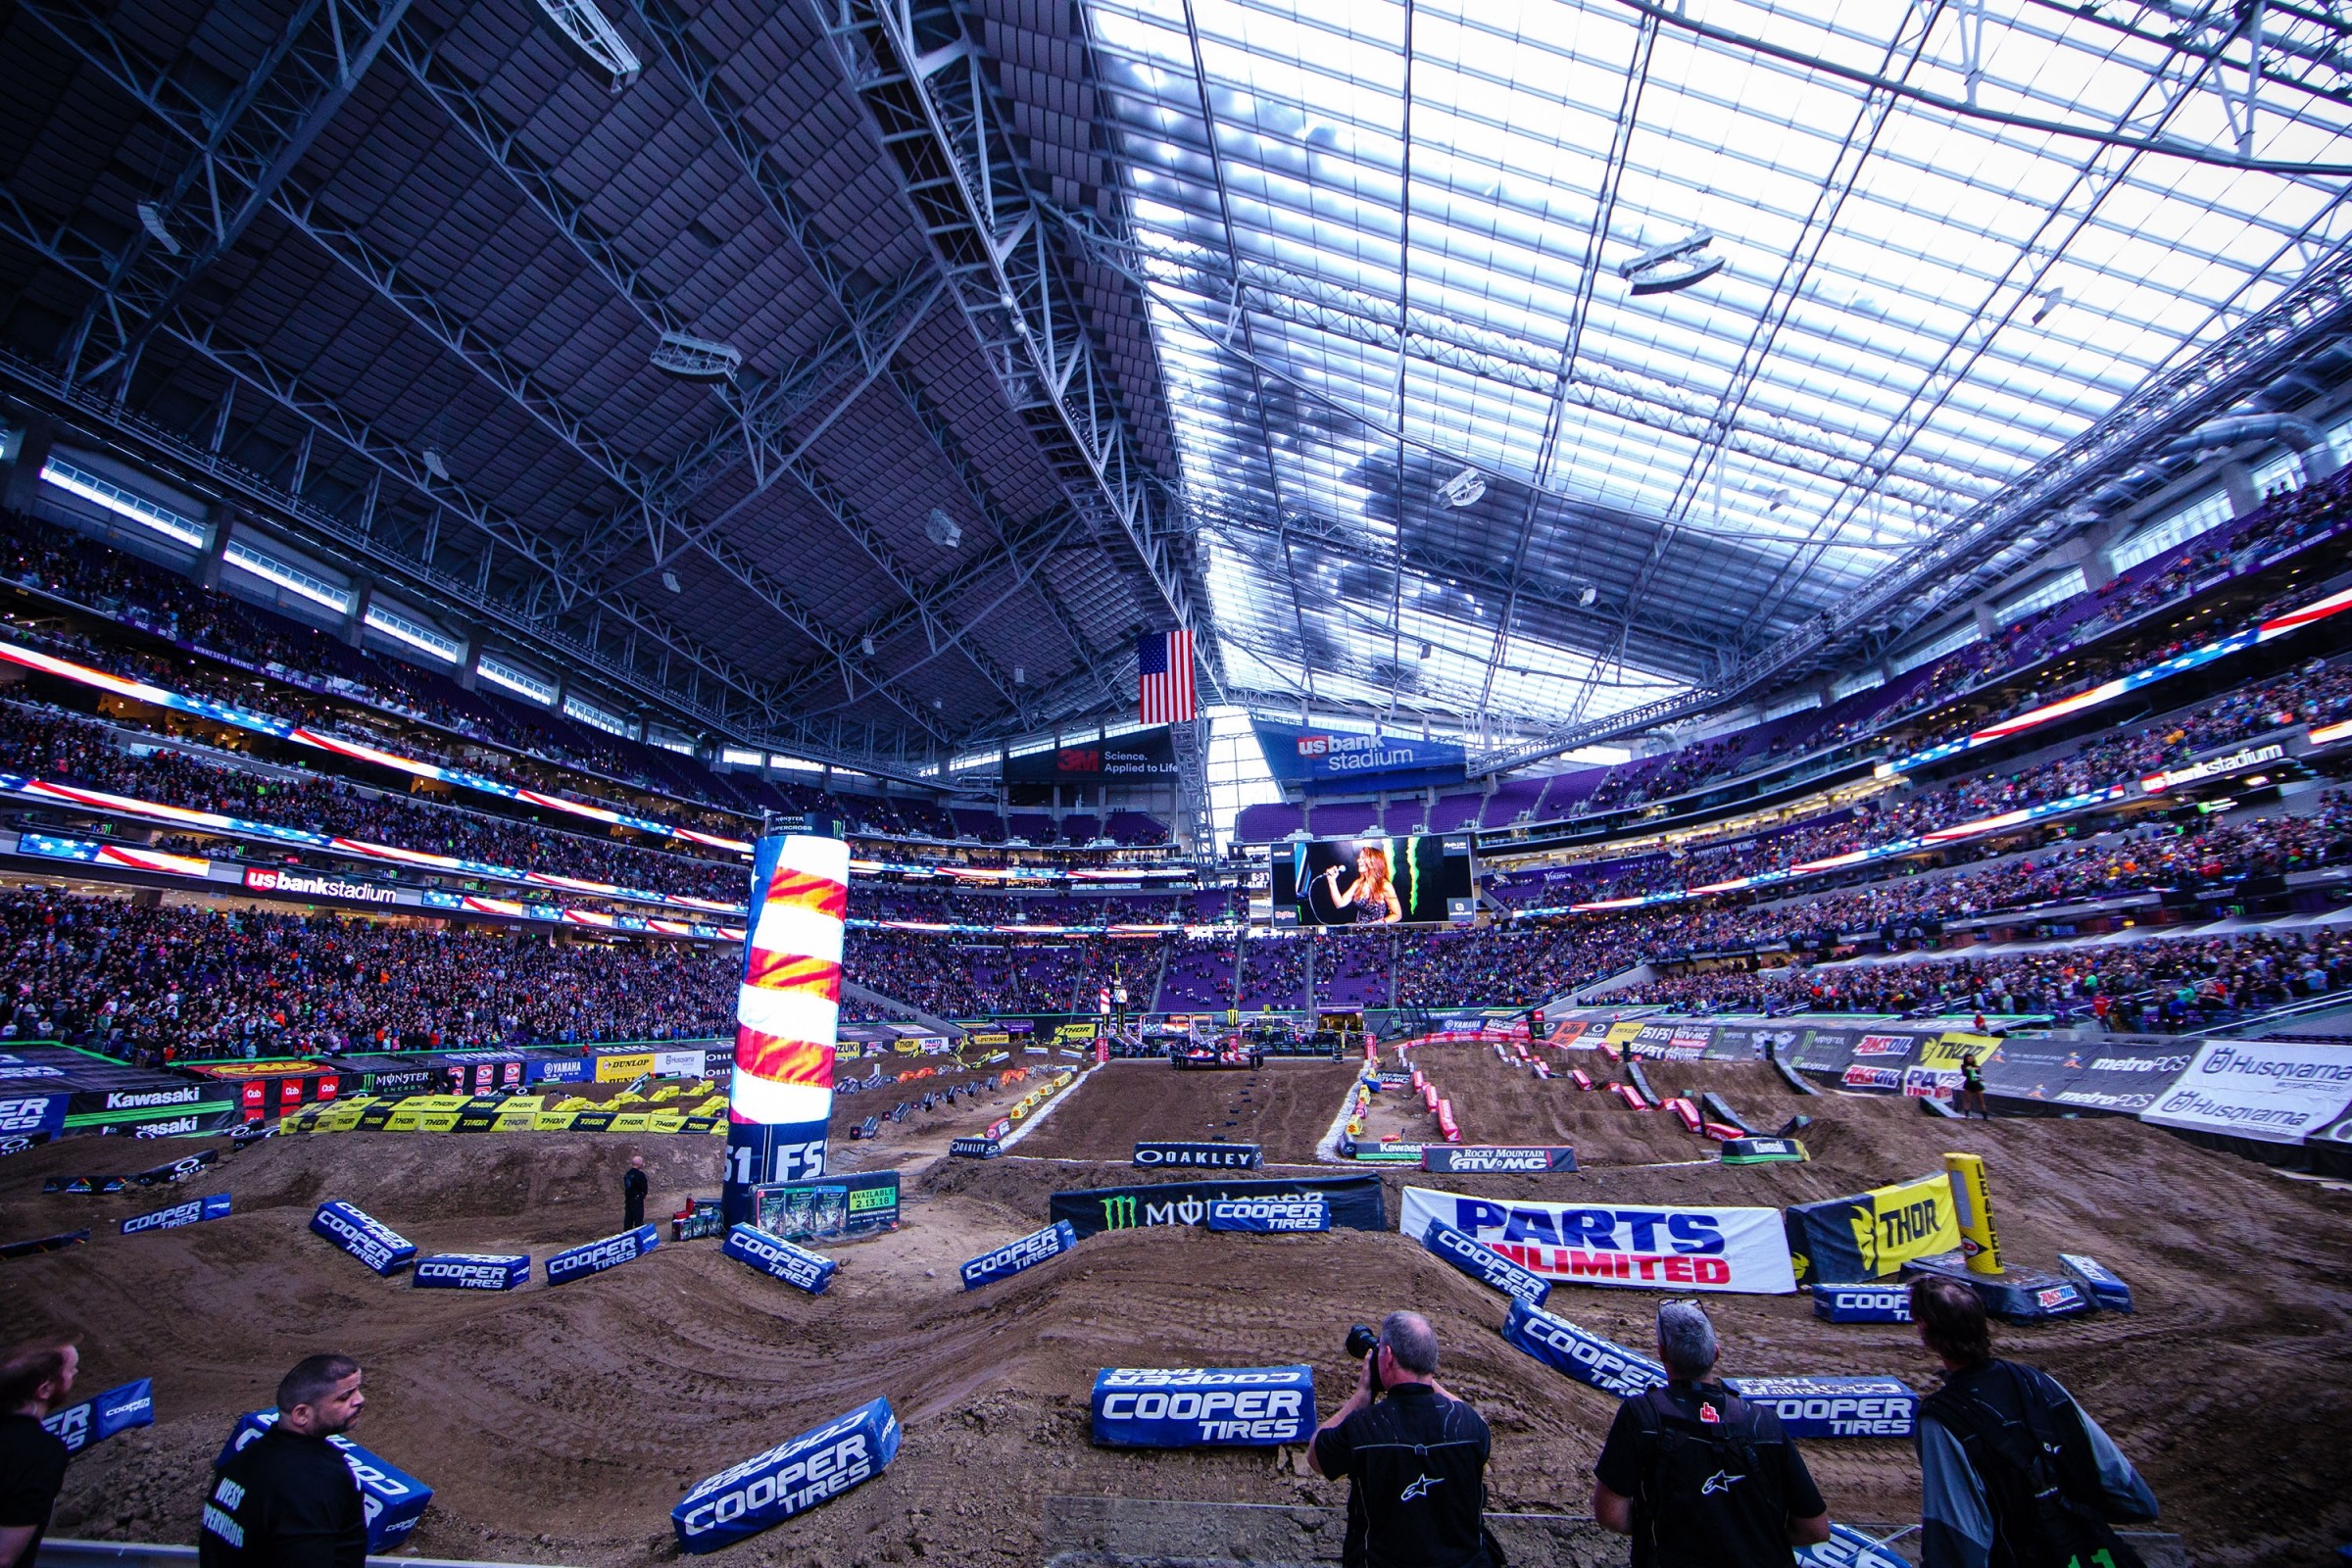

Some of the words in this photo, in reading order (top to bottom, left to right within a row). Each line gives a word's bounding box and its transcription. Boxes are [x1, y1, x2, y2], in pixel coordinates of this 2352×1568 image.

[1056, 749, 1099, 772] 3M
[1104, 751, 1148, 760] Science.
[1328, 748, 1413, 770] stadium
[1104, 762, 1145, 774] Applied
[1856, 1037, 1913, 1054] AMSOIL
[553, 1060, 582, 1072] YAMAHA
[612, 1058, 649, 1068] DUNLOP
[2090, 1054, 2191, 1072] metroPCS
[2228, 1054, 2352, 1081] Husqvarna
[376, 1072, 429, 1087] MONSTER
[1844, 1066, 1902, 1088] AMSOIL
[107, 1087, 200, 1109] Kawasaki
[2054, 1091, 2156, 1108] metroPCS
[424, 1118, 449, 1127] THOR
[579, 1117, 606, 1126] THOR
[2185, 1098, 2311, 1126] Husqvarna
[655, 1120, 676, 1129] THOR
[687, 1121, 710, 1131] THOR
[1165, 1151, 1250, 1166] OAKLEY
[1464, 1149, 1494, 1158] ROCKY
[1495, 1150, 1544, 1158] MOUNTAIN
[851, 1188, 895, 1200] AVAILABLE
[856, 1196, 890, 1207] 2.13.18
[123, 1200, 202, 1234] COOPER
[160, 1213, 200, 1229] TIRES
[1215, 1203, 1324, 1217] COOPER
[1976, 1162, 2003, 1268] LEADER
[334, 1201, 414, 1249] COOPER
[1266, 1218, 1322, 1230] TIRES
[1456, 1198, 1725, 1254] PARTS
[1880, 1199, 1940, 1249] THOR
[318, 1210, 394, 1263] COOPER
[361, 1225, 401, 1250] TIRES
[345, 1241, 383, 1270] TIRES
[549, 1237, 637, 1275] COOPER
[592, 1249, 637, 1272] TIRES
[729, 1231, 821, 1280] COOPER
[965, 1231, 1058, 1279] COOPER
[1012, 1248, 1059, 1271] TIRES
[1437, 1231, 1546, 1296] COOPER
[417, 1262, 508, 1280] COOPER
[768, 1261, 815, 1289] TIRES
[459, 1278, 505, 1288] TIRES
[1484, 1268, 1540, 1303] TIRES
[2040, 1286, 2078, 1306] AMSOIL
[105, 1396, 151, 1417] COOPER
[1102, 1390, 1303, 1420] COOPER
[1198, 1419, 1300, 1441] TIRES
[1829, 1419, 1911, 1435] TIRES
[684, 1433, 866, 1537] COOPER
[777, 1458, 870, 1515] TIRES
